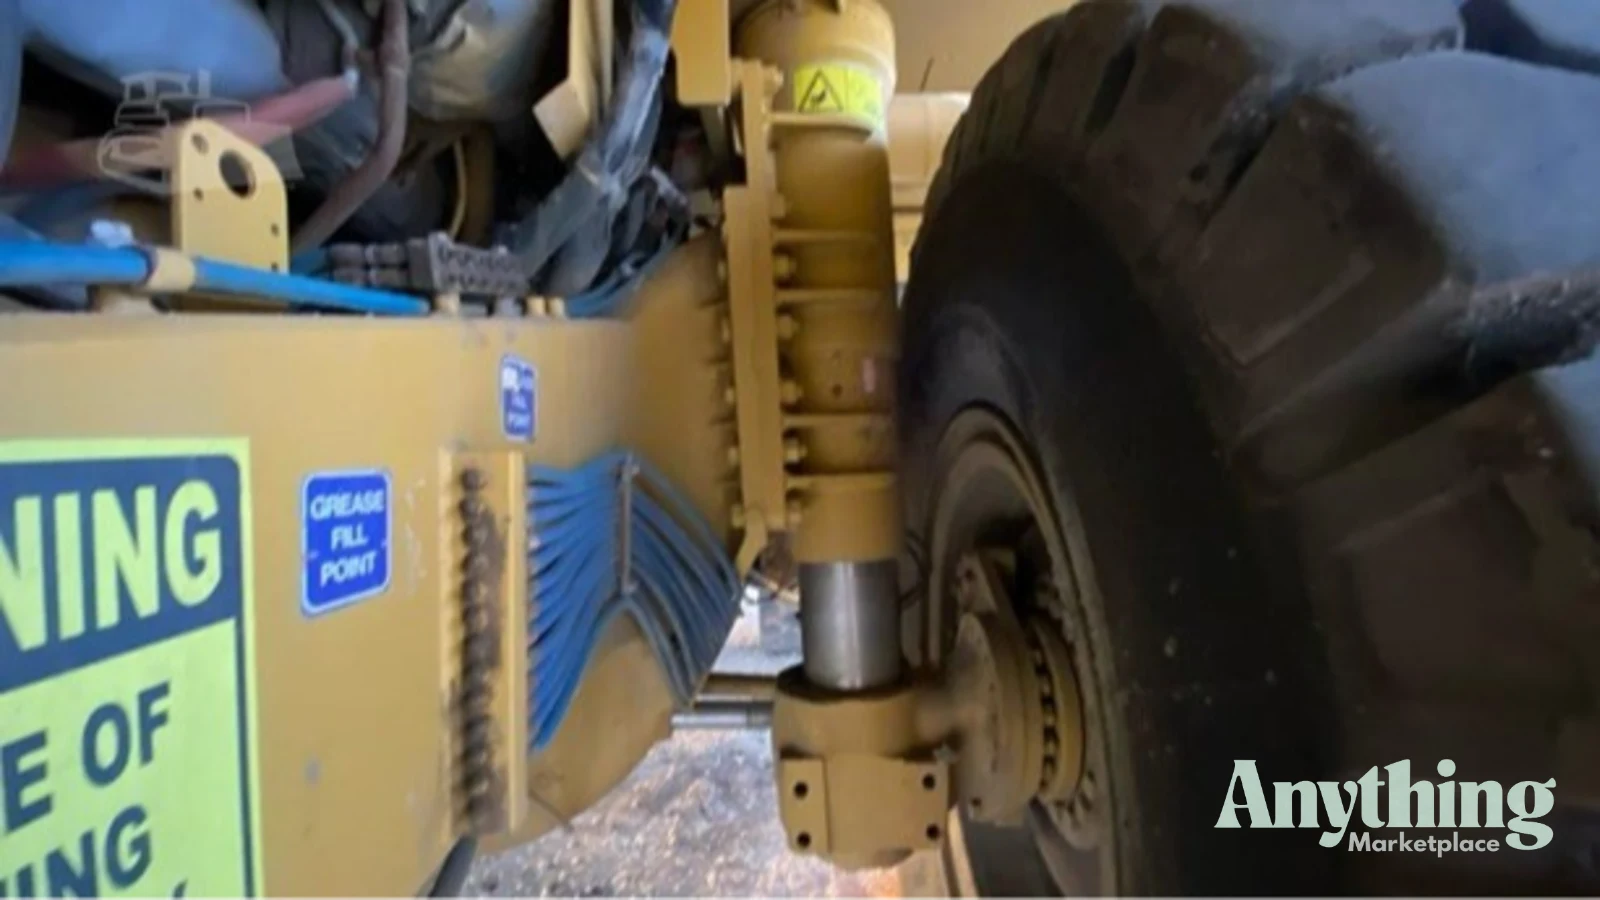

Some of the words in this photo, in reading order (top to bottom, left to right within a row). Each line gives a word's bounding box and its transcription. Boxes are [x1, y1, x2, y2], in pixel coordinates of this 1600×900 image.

[310, 490, 385, 521] GREASE
[331, 524, 369, 551] FILL
[320, 549, 377, 588] POINT
[81, 681, 171, 787] OF
[0, 804, 152, 897] ING
